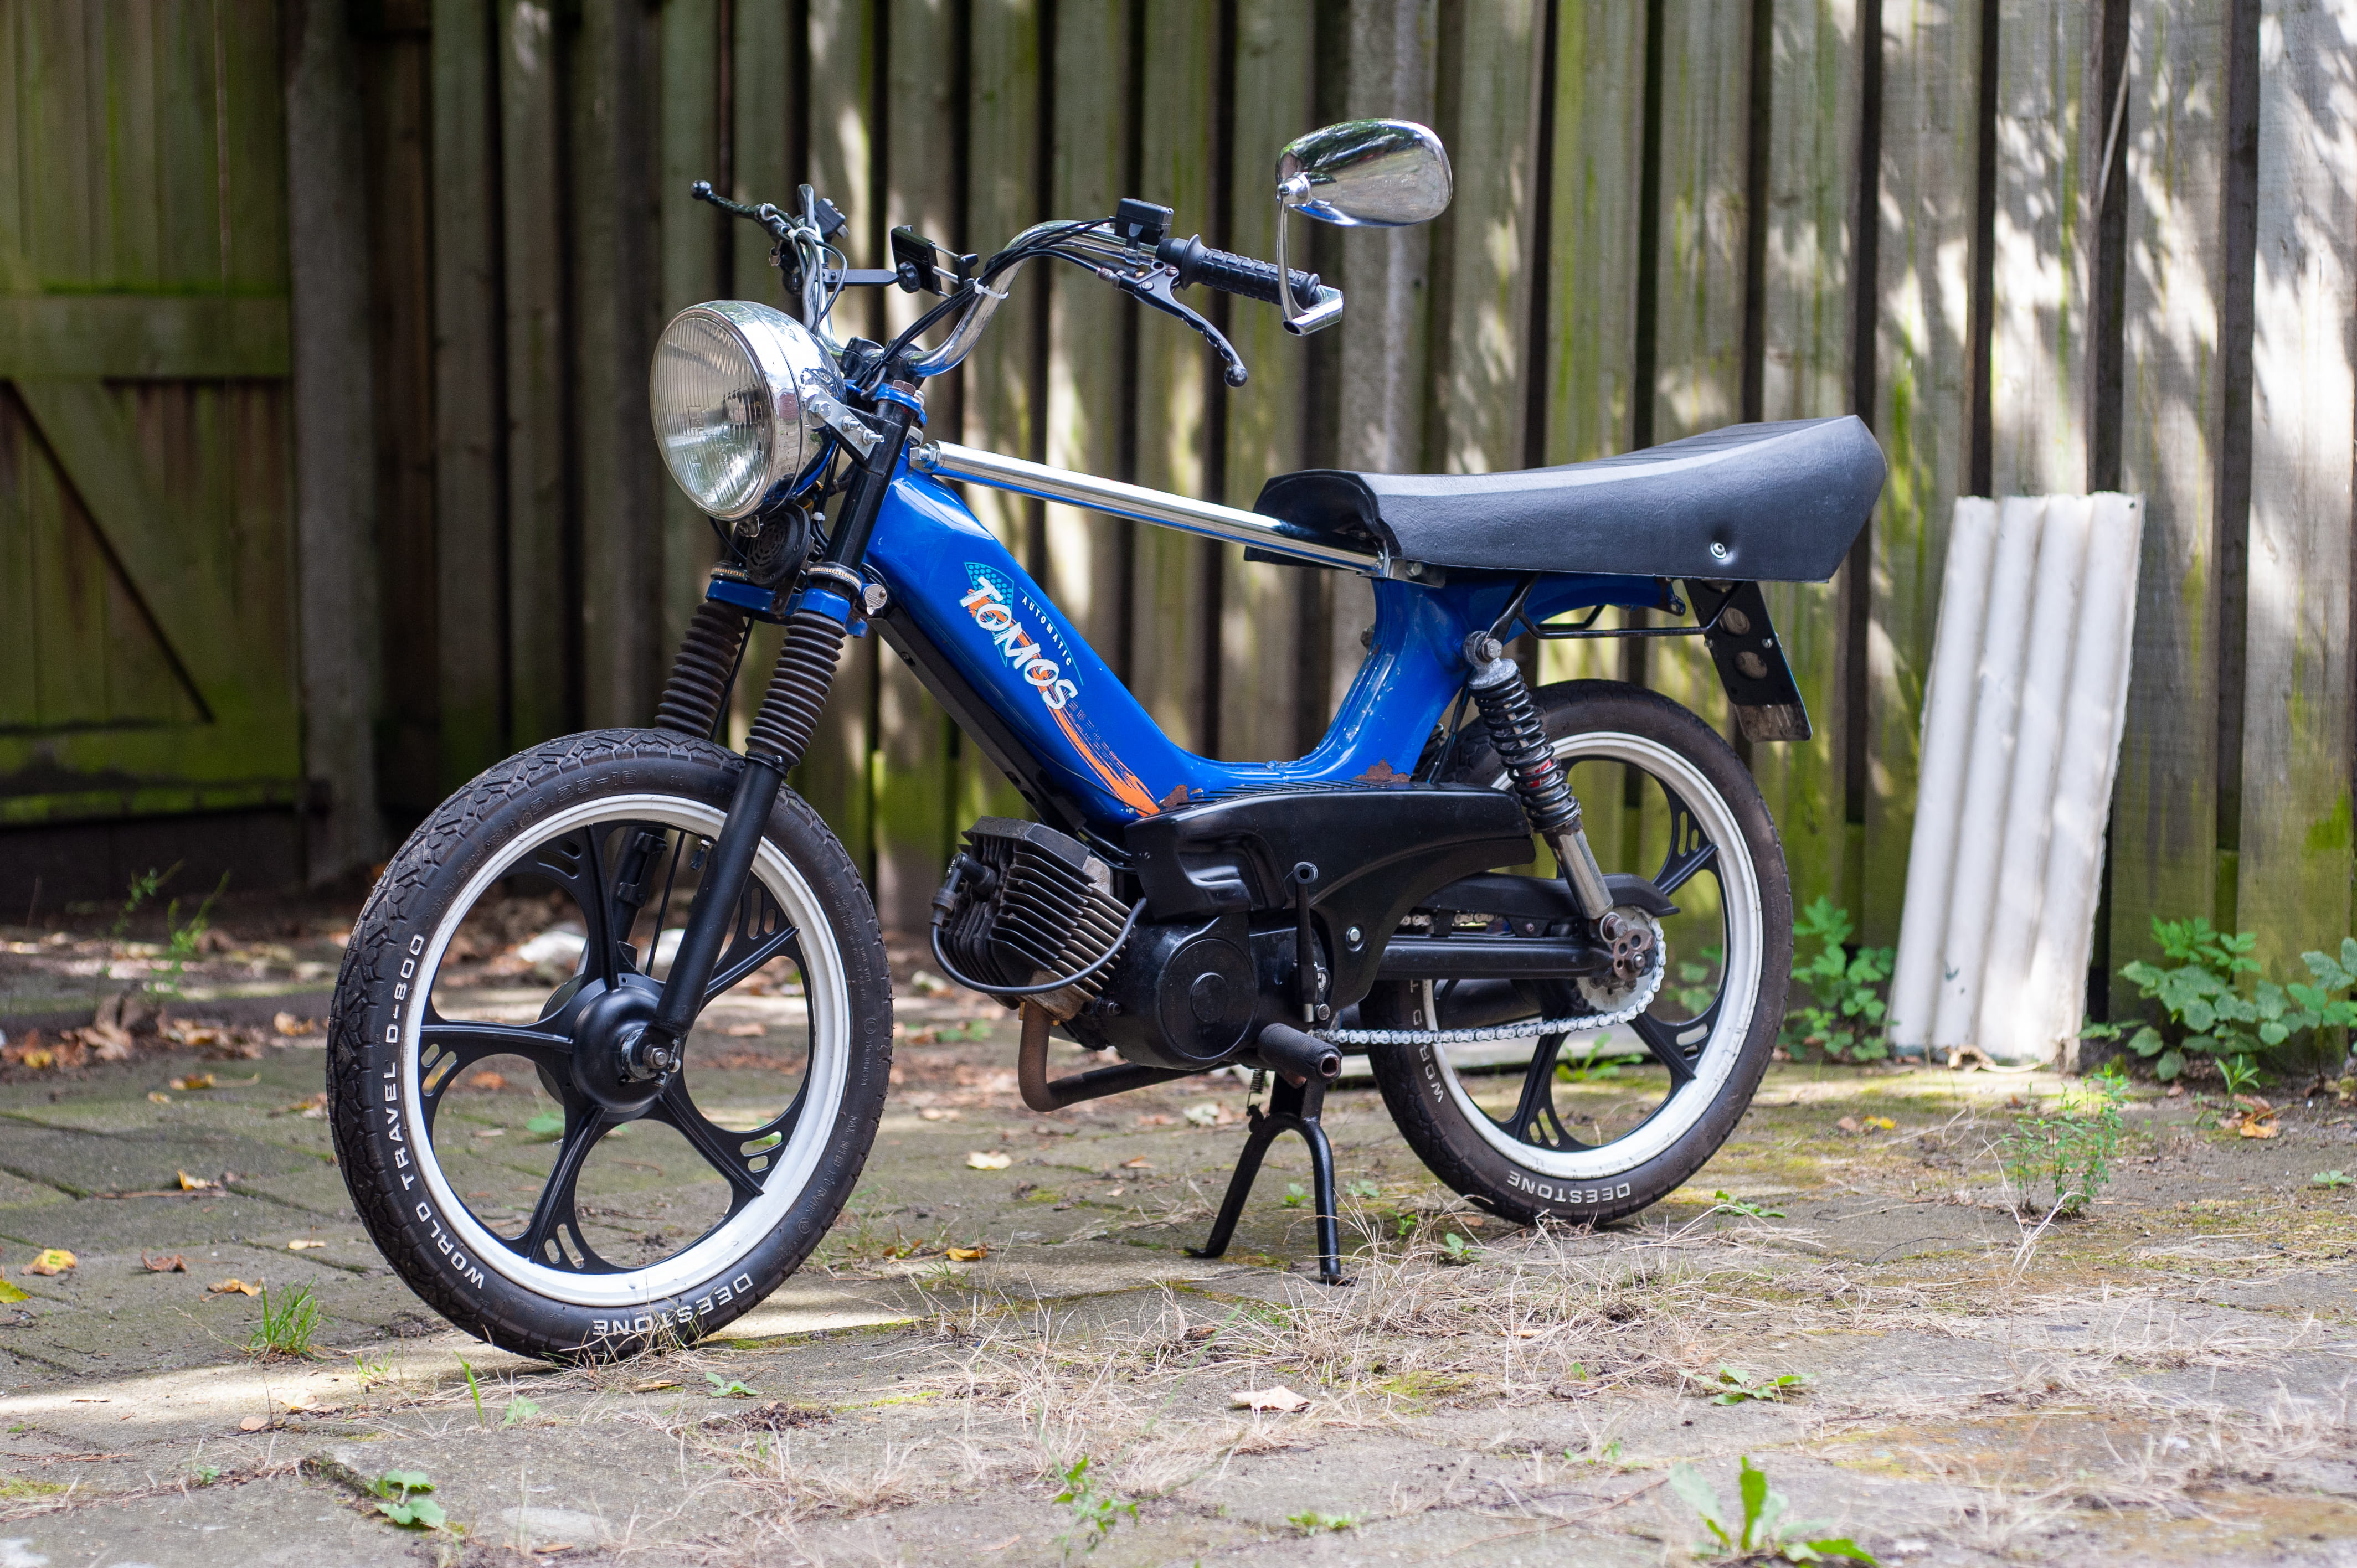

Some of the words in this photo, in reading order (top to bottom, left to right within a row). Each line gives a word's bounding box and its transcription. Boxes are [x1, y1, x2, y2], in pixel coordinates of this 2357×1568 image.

[959, 576, 1078, 709] TOMOS
[1022, 596, 1072, 666] AUTOMATIC
[385, 933, 425, 1044] D-800
[1413, 1009, 1444, 1103] WORD
[383, 1062, 414, 1191] TRAVEL
[1507, 1170, 1630, 1204] DEESTONE
[415, 1201, 485, 1290] WORLD
[593, 1273, 754, 1335] DEESTONE
